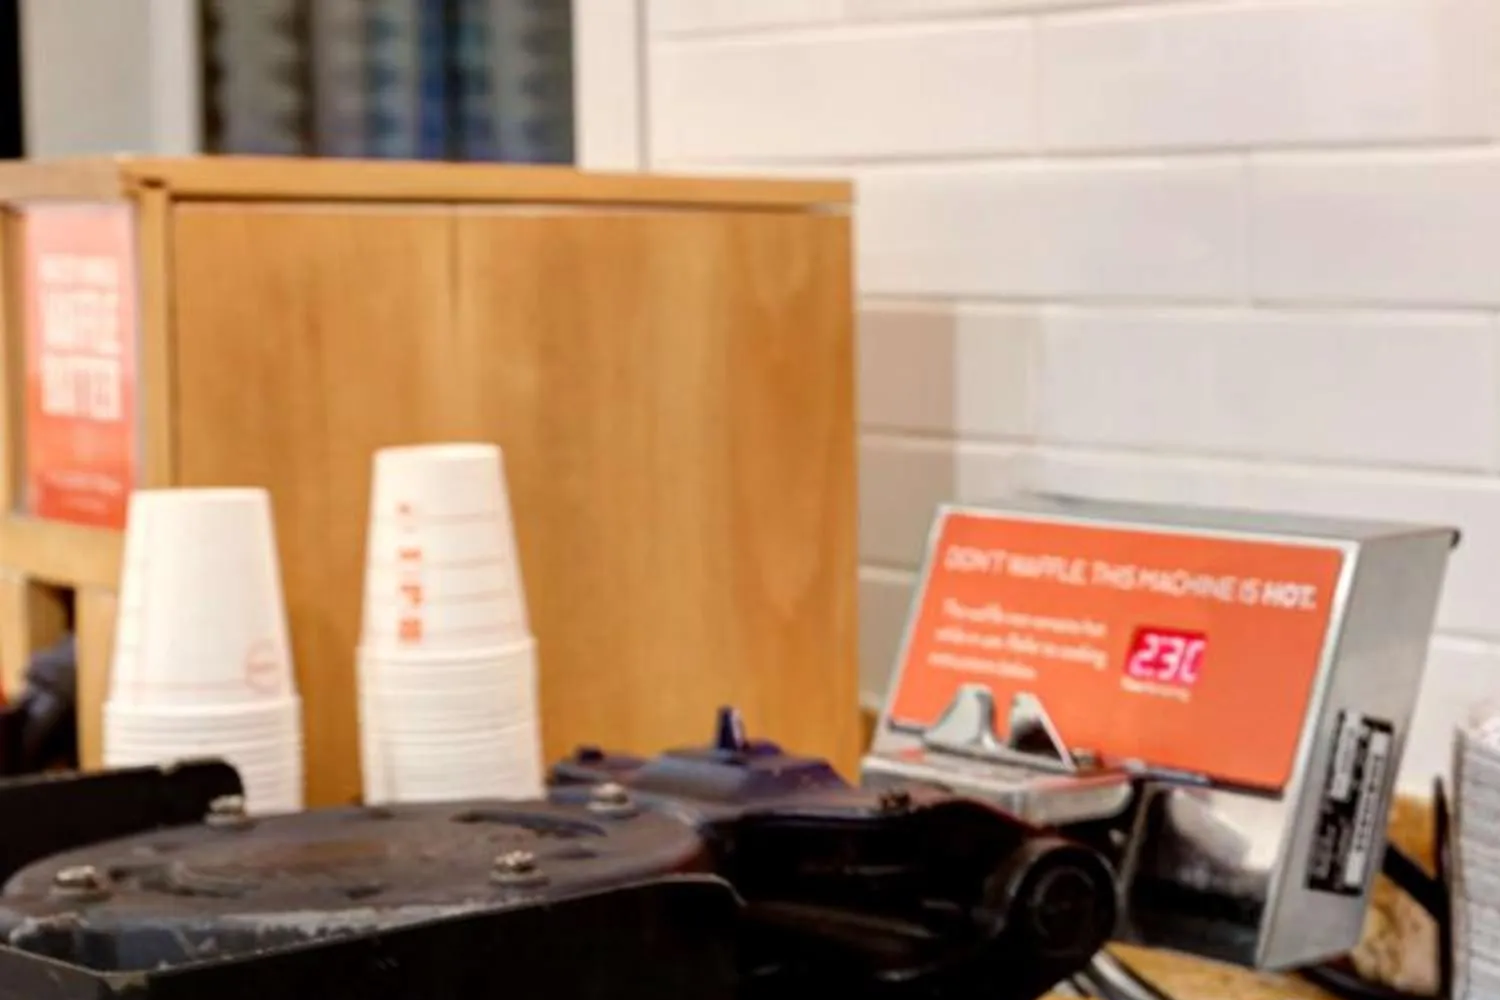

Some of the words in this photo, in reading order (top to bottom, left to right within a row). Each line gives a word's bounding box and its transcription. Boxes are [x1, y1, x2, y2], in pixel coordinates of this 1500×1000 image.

[1090, 559, 1137, 591] THIS
[1137, 565, 1238, 603] MACHINE
[1239, 576, 1263, 607] IS
